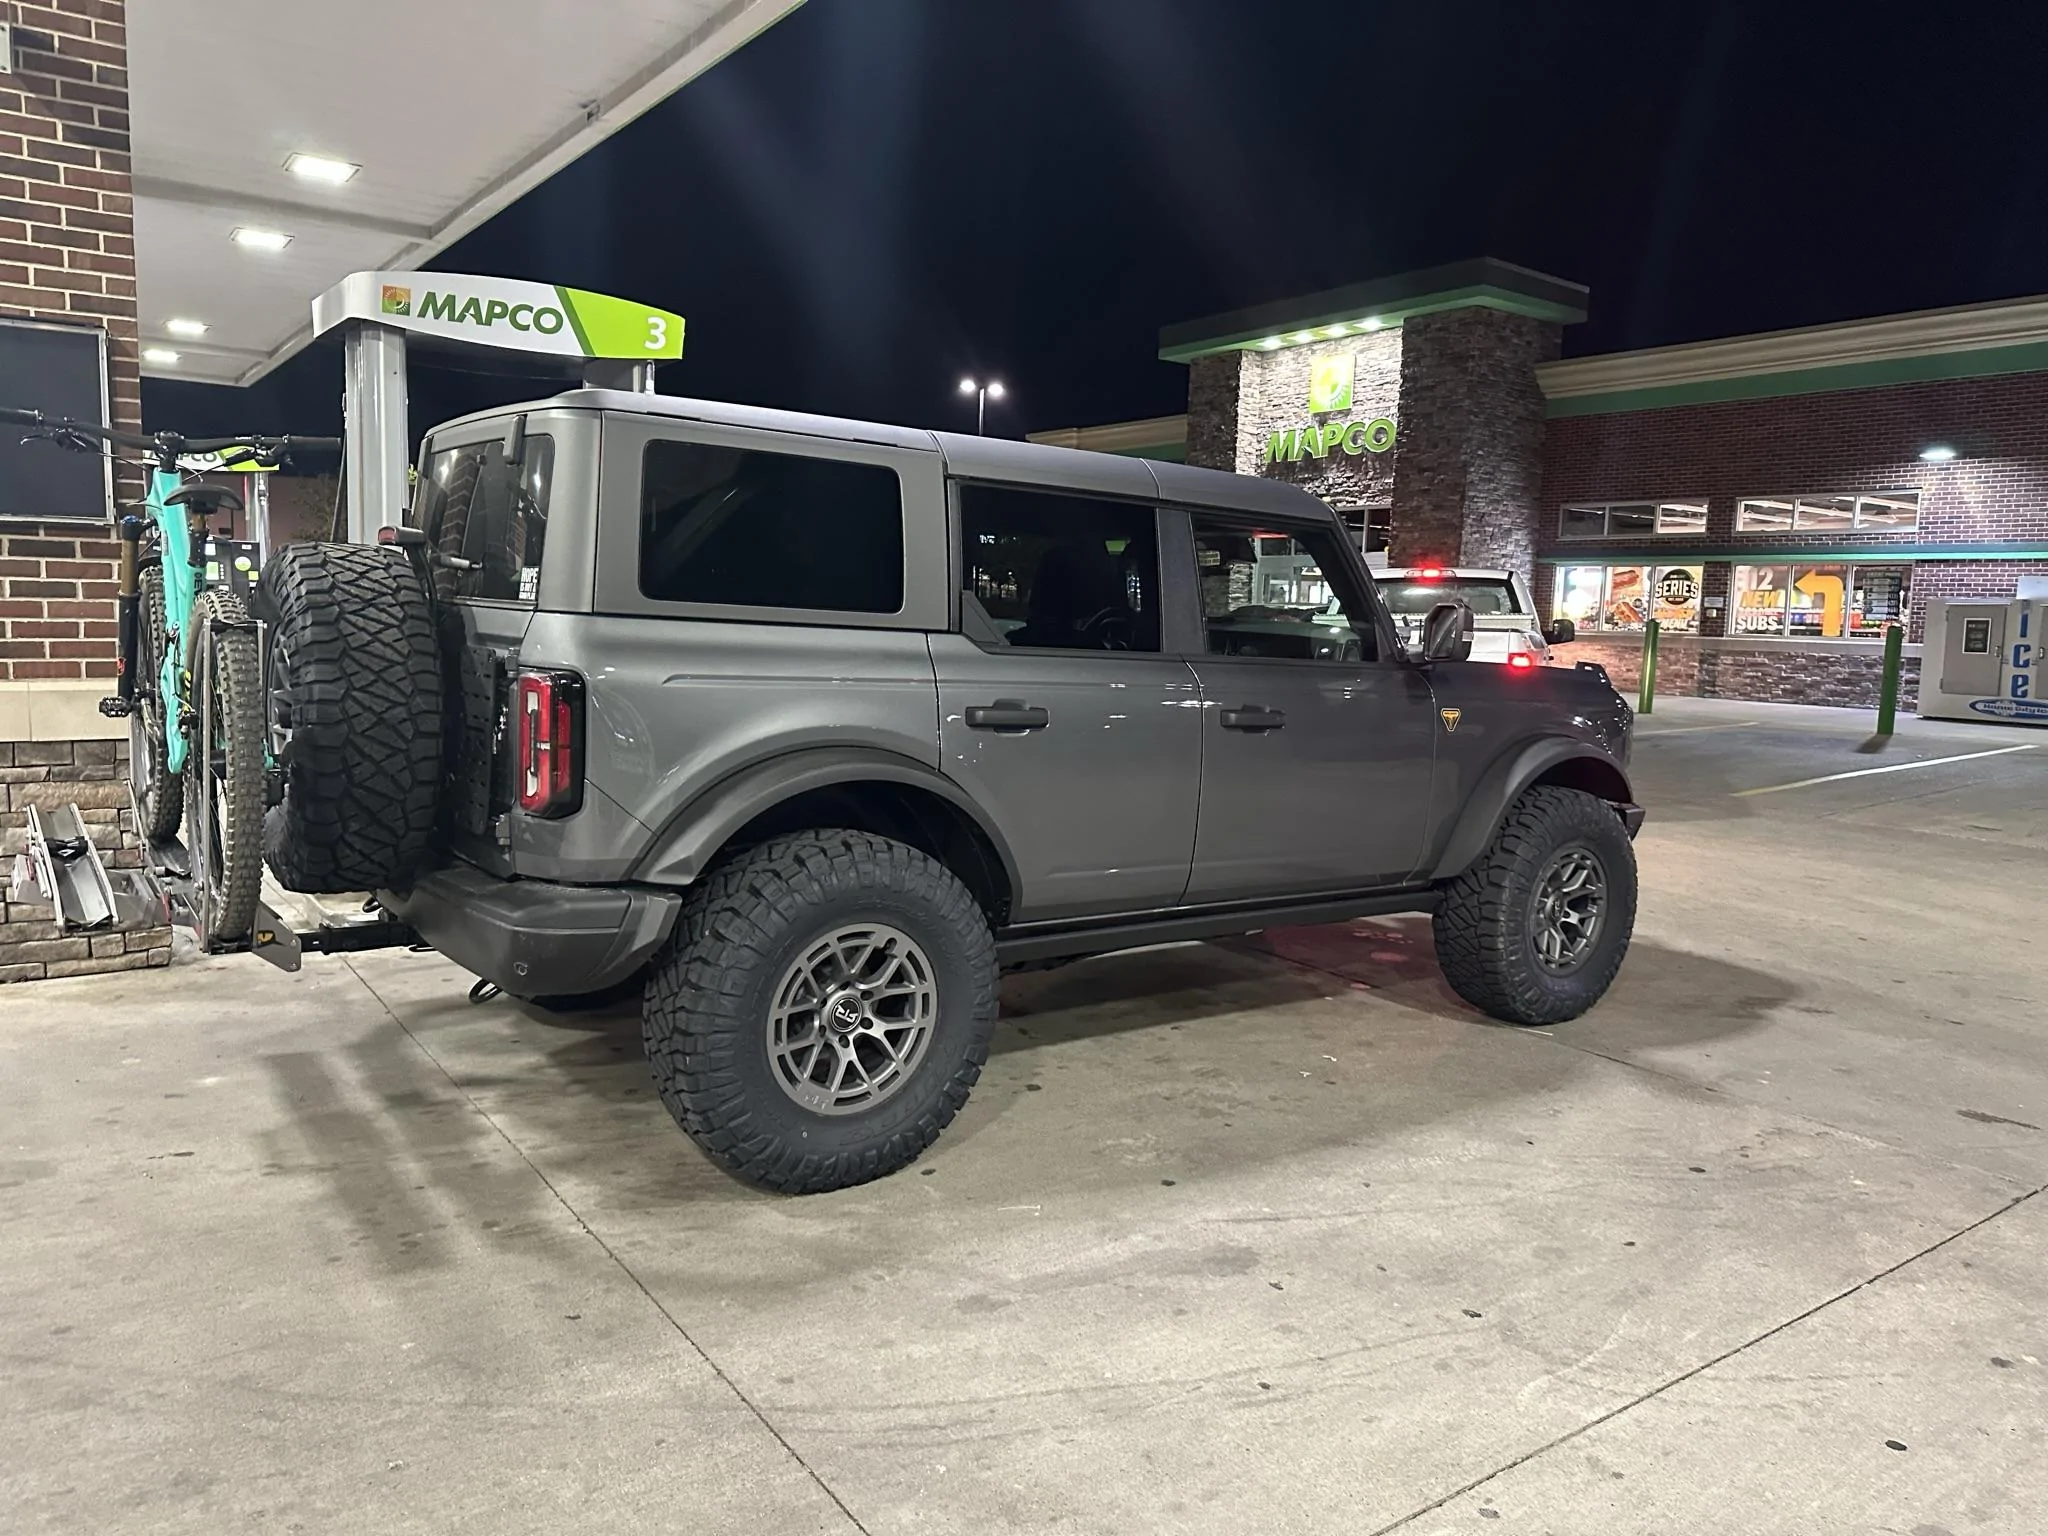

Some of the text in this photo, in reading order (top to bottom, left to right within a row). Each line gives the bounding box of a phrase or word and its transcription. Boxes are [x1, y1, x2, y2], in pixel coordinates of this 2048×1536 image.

[417, 291, 563, 335] MAPCO
[644, 316, 667, 350] 3
[1264, 417, 1397, 464] MAPCO
[1655, 580, 1698, 599] SERIES
[1749, 566, 1774, 590] 12
[1741, 591, 1779, 608] NEW
[1737, 615, 1778, 631] SUBS
